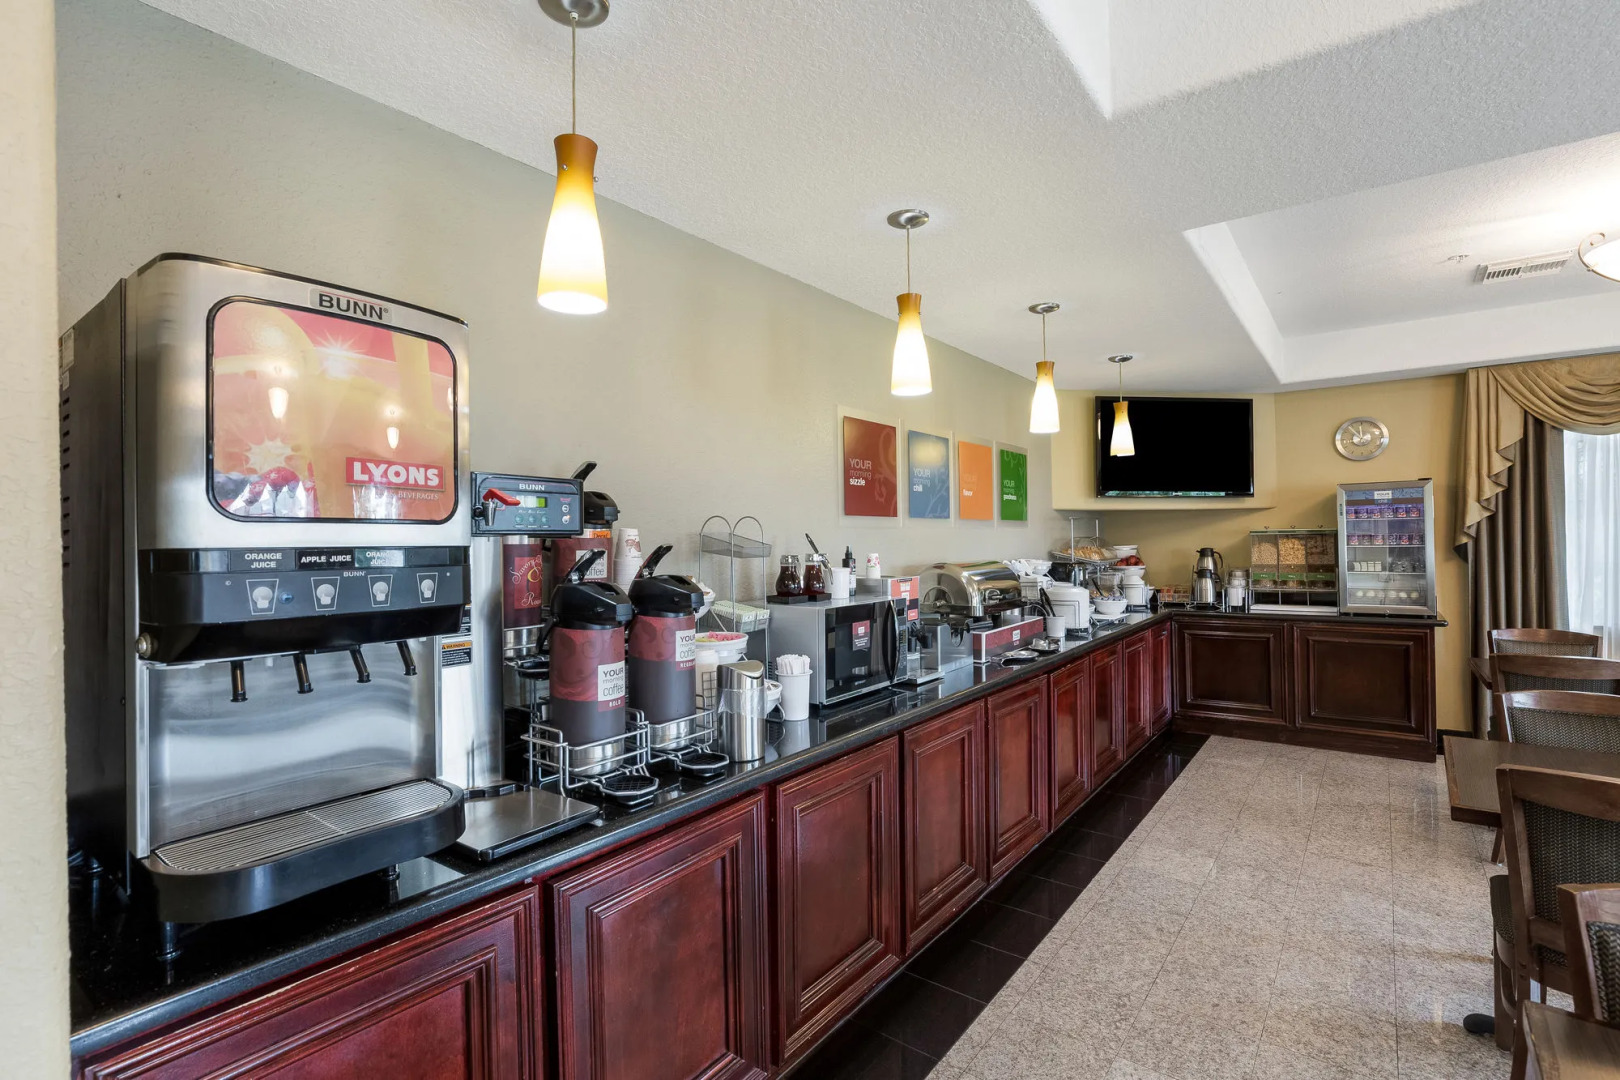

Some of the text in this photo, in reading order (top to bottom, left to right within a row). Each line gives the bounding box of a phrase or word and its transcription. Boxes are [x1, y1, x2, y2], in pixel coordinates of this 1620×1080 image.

[318, 292, 384, 321] BUNN
[848, 457, 872, 470] YOUR
[353, 460, 440, 487] LYONS
[849, 469, 872, 481] morning
[913, 467, 931, 478] YOUR
[849, 477, 866, 486] sizzle
[1003, 479, 1015, 488] YOUR
[518, 483, 545, 491] BUNN
[913, 484, 923, 492] chill
[398, 490, 439, 500] BEVERAGES
[244, 552, 282, 560] ORANGE
[300, 554, 352, 563] APPLE JUICE
[250, 561, 277, 569] JUICE
[584, 566, 605, 578] offee
[602, 667, 624, 678] YOUR
[602, 682, 624, 697] coffee
[608, 699, 622, 708] BOLD
